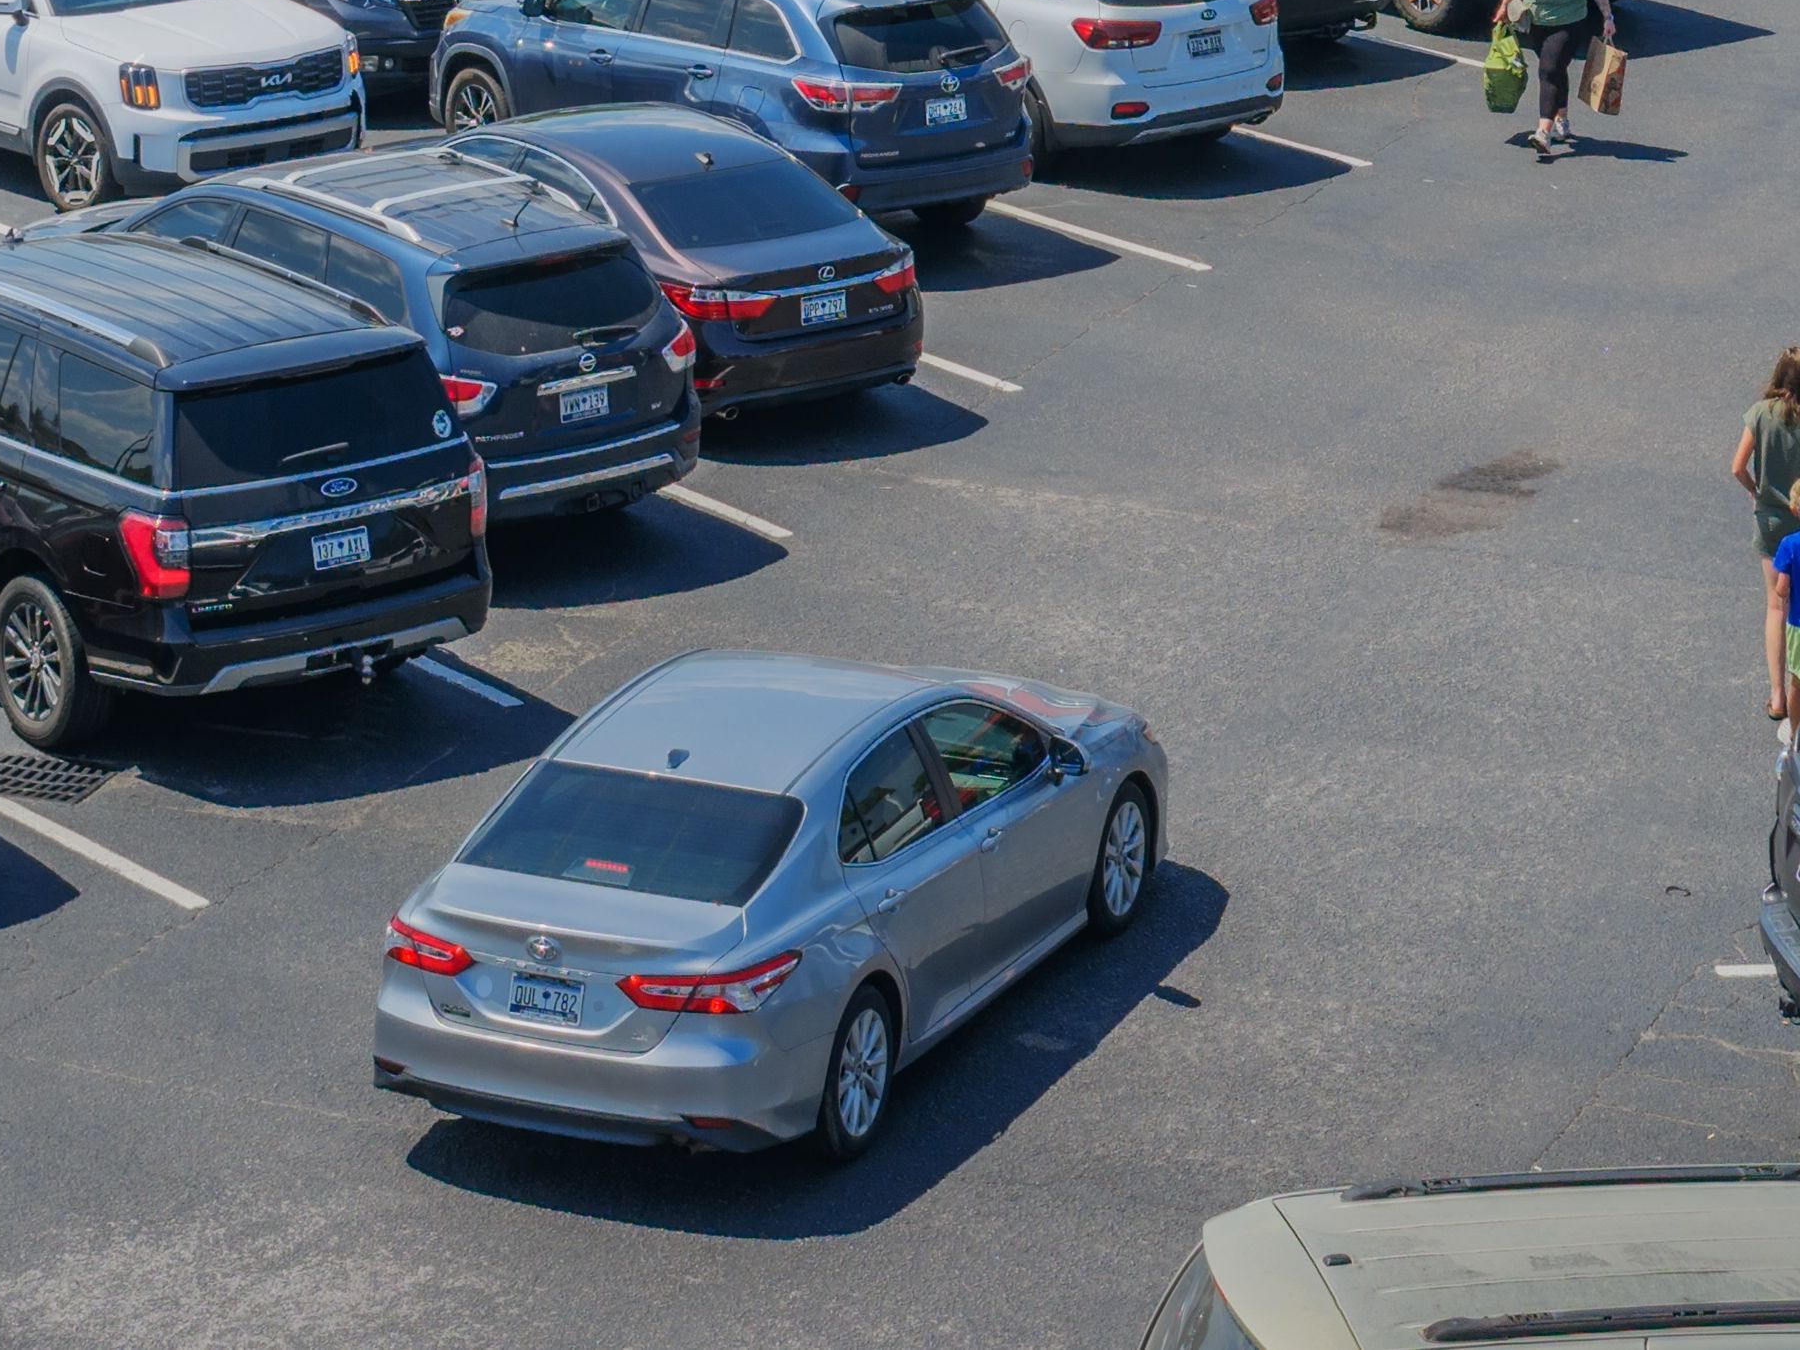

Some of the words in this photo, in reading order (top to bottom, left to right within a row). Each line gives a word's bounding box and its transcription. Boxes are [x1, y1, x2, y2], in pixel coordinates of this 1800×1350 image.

[827, 298, 843, 315] 797
[588, 392, 605, 409] 139
[317, 539, 335, 560] 137
[346, 536, 367, 555] AXL
[191, 603, 233, 614] LIMITED
[514, 985, 539, 1008] QUL
[553, 991, 578, 1014] 782
